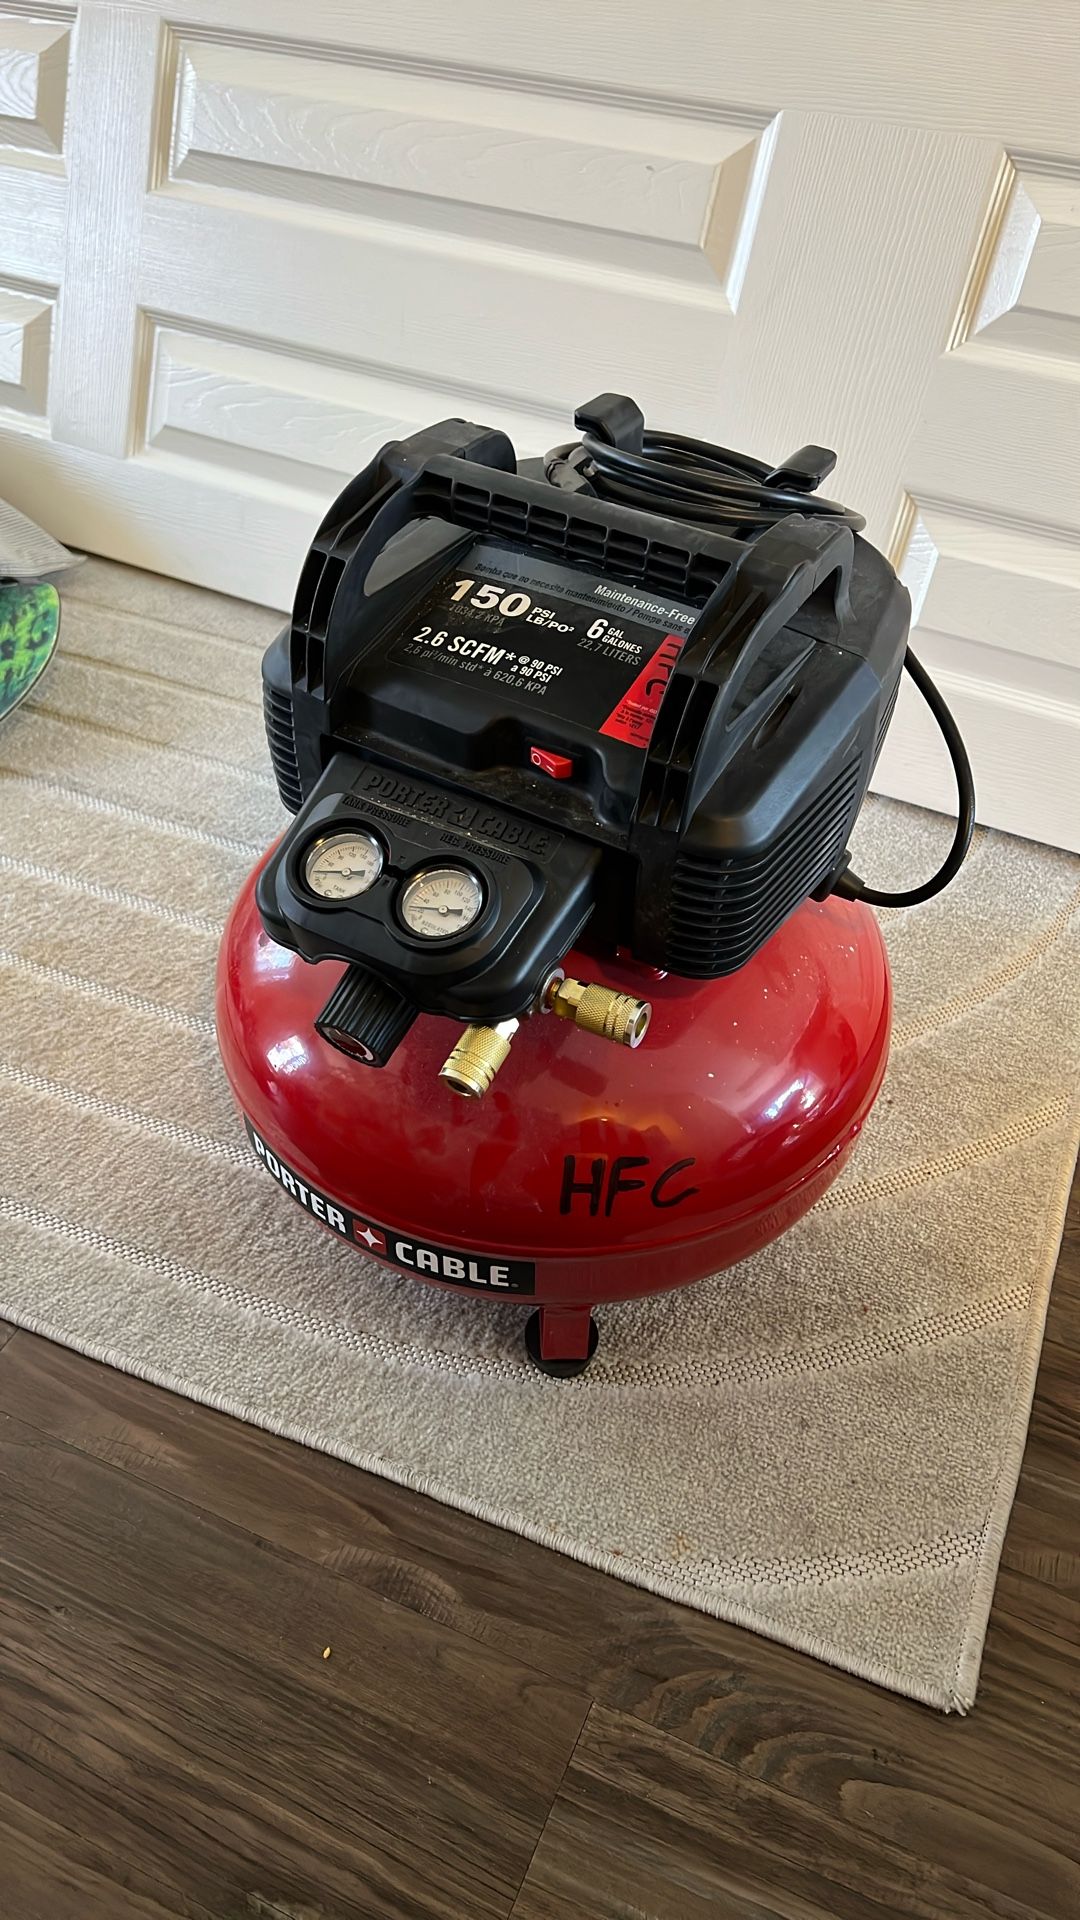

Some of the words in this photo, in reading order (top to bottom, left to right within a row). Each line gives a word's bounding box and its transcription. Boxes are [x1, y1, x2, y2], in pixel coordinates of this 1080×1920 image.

[450, 579, 532, 617] 150
[501, 570, 518, 581] que
[519, 575, 530, 583] no
[530, 577, 565, 593] necesita
[565, 587, 627, 614] mantenimiento
[632, 608, 662, 626] Pompe
[662, 620, 683, 633] sans
[594, 584, 696, 626] Maintenance-Free
[484, 612, 505, 627] KPA
[531, 606, 556, 620] PSI
[586, 618, 609, 640] 6
[607, 626, 625, 639] GAL
[412, 626, 449, 648] 2.6
[531, 659, 545, 670] 90
[545, 664, 564, 677] PSI
[601, 634, 643, 655] GALONES
[602, 646, 642, 666] LITERS
[520, 667, 534, 677] 90
[533, 671, 553, 683] PSI
[524, 680, 548, 695] KPA
[342, 796, 364, 812] TANK
[366, 803, 411, 828] PRESSURE
[363, 773, 450, 820] PORTER
[477, 816, 550, 855] CABLE
[464, 840, 512, 865] PRESSURE
[559, 1154, 699, 1218] HFC
[252, 1131, 348, 1234] PORTER
[395, 1241, 511, 1287] CABLE
